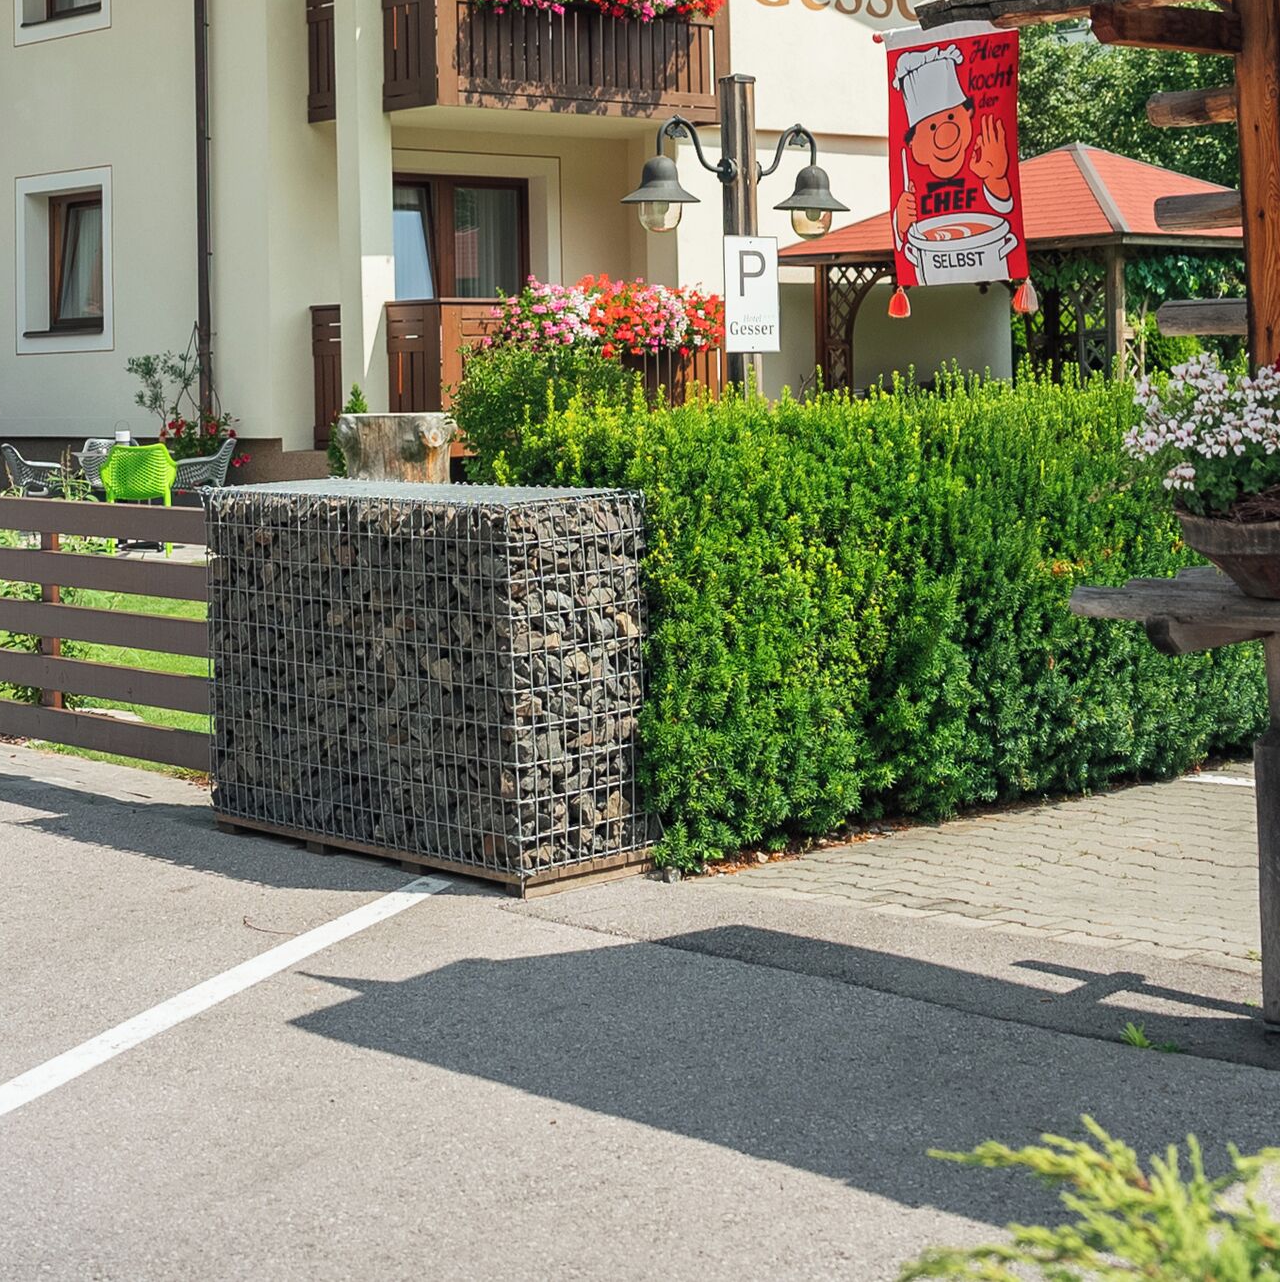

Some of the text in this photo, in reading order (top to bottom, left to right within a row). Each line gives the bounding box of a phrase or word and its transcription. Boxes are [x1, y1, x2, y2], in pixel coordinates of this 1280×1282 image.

[969, 39, 1010, 64] Hier
[968, 63, 1014, 92] kocht
[978, 92, 999, 109] der
[921, 187, 978, 216] CHEF
[932, 251, 985, 269] SELBST
[739, 250, 766, 297] P
[729, 320, 775, 336] Gesser
